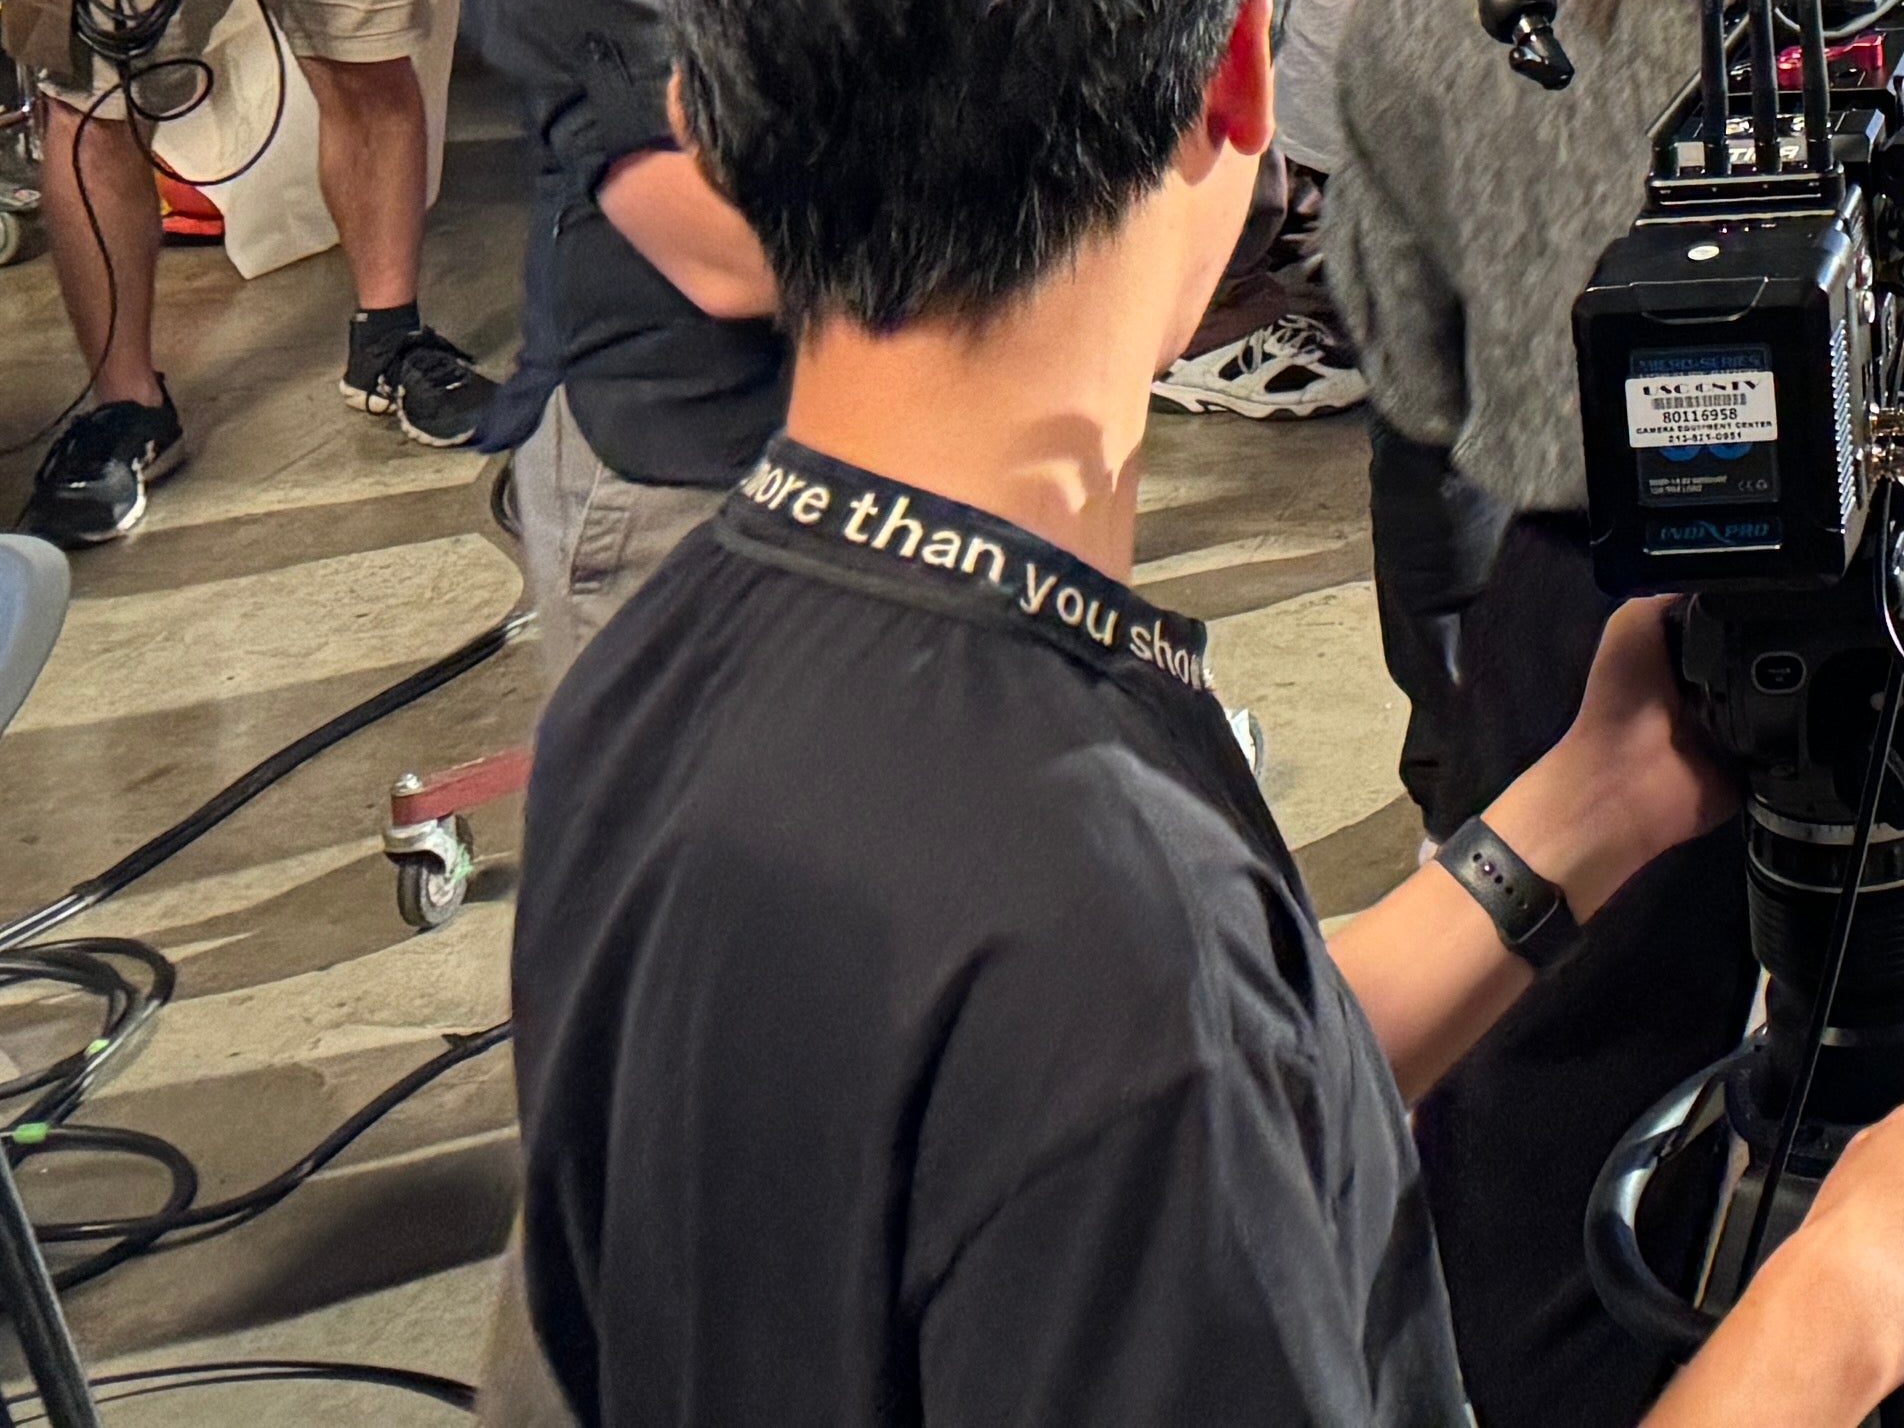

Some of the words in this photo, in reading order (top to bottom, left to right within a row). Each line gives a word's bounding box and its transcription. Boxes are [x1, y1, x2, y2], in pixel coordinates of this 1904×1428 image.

[1728, 145, 1800, 164] TIA
[1643, 383, 1689, 396] USC
[1662, 408, 1738, 423] 80116958
[1636, 426, 1675, 434] CAMERA
[1677, 422, 1732, 432] EQUIPMENT
[1735, 420, 1772, 429] CENTER
[843, 490, 1007, 582] than
[1018, 560, 1121, 647] you
